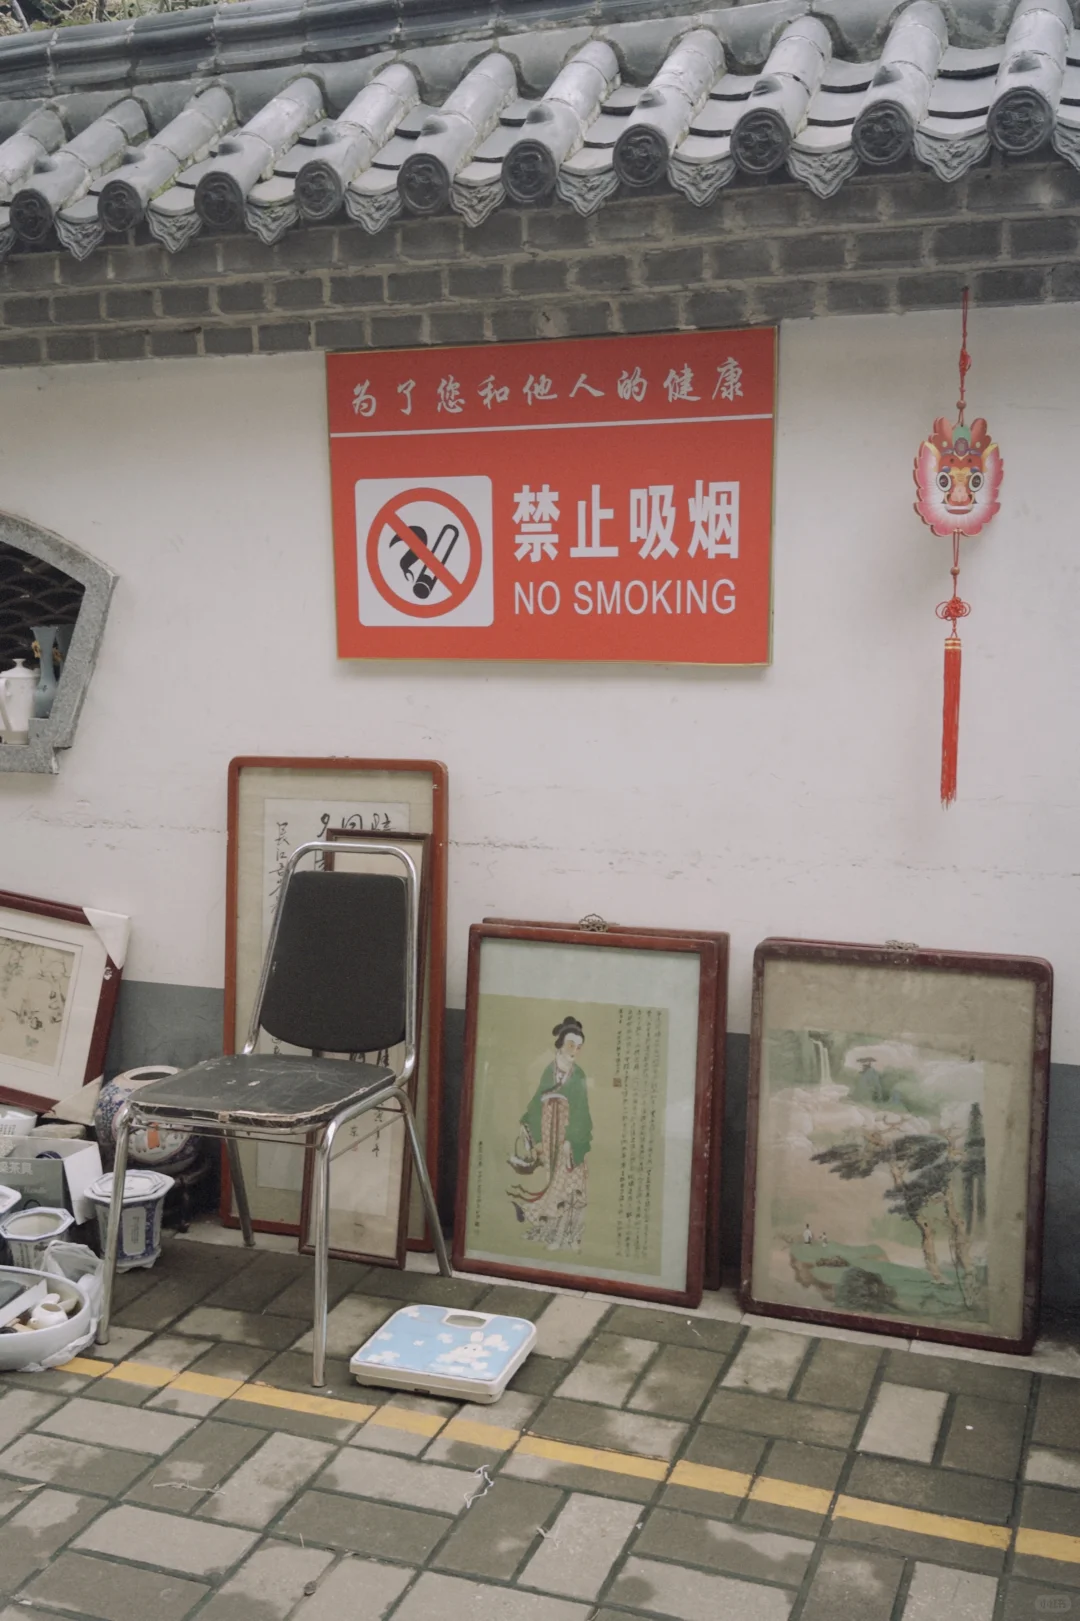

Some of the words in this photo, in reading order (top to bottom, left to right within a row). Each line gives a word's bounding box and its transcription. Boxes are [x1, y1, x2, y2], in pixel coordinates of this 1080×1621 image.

[352, 357, 744, 417] 为了您和他人的健康
[511, 479, 741, 563] 禁止吸烟
[514, 581, 561, 616] NO
[573, 578, 737, 616] SMOKING
